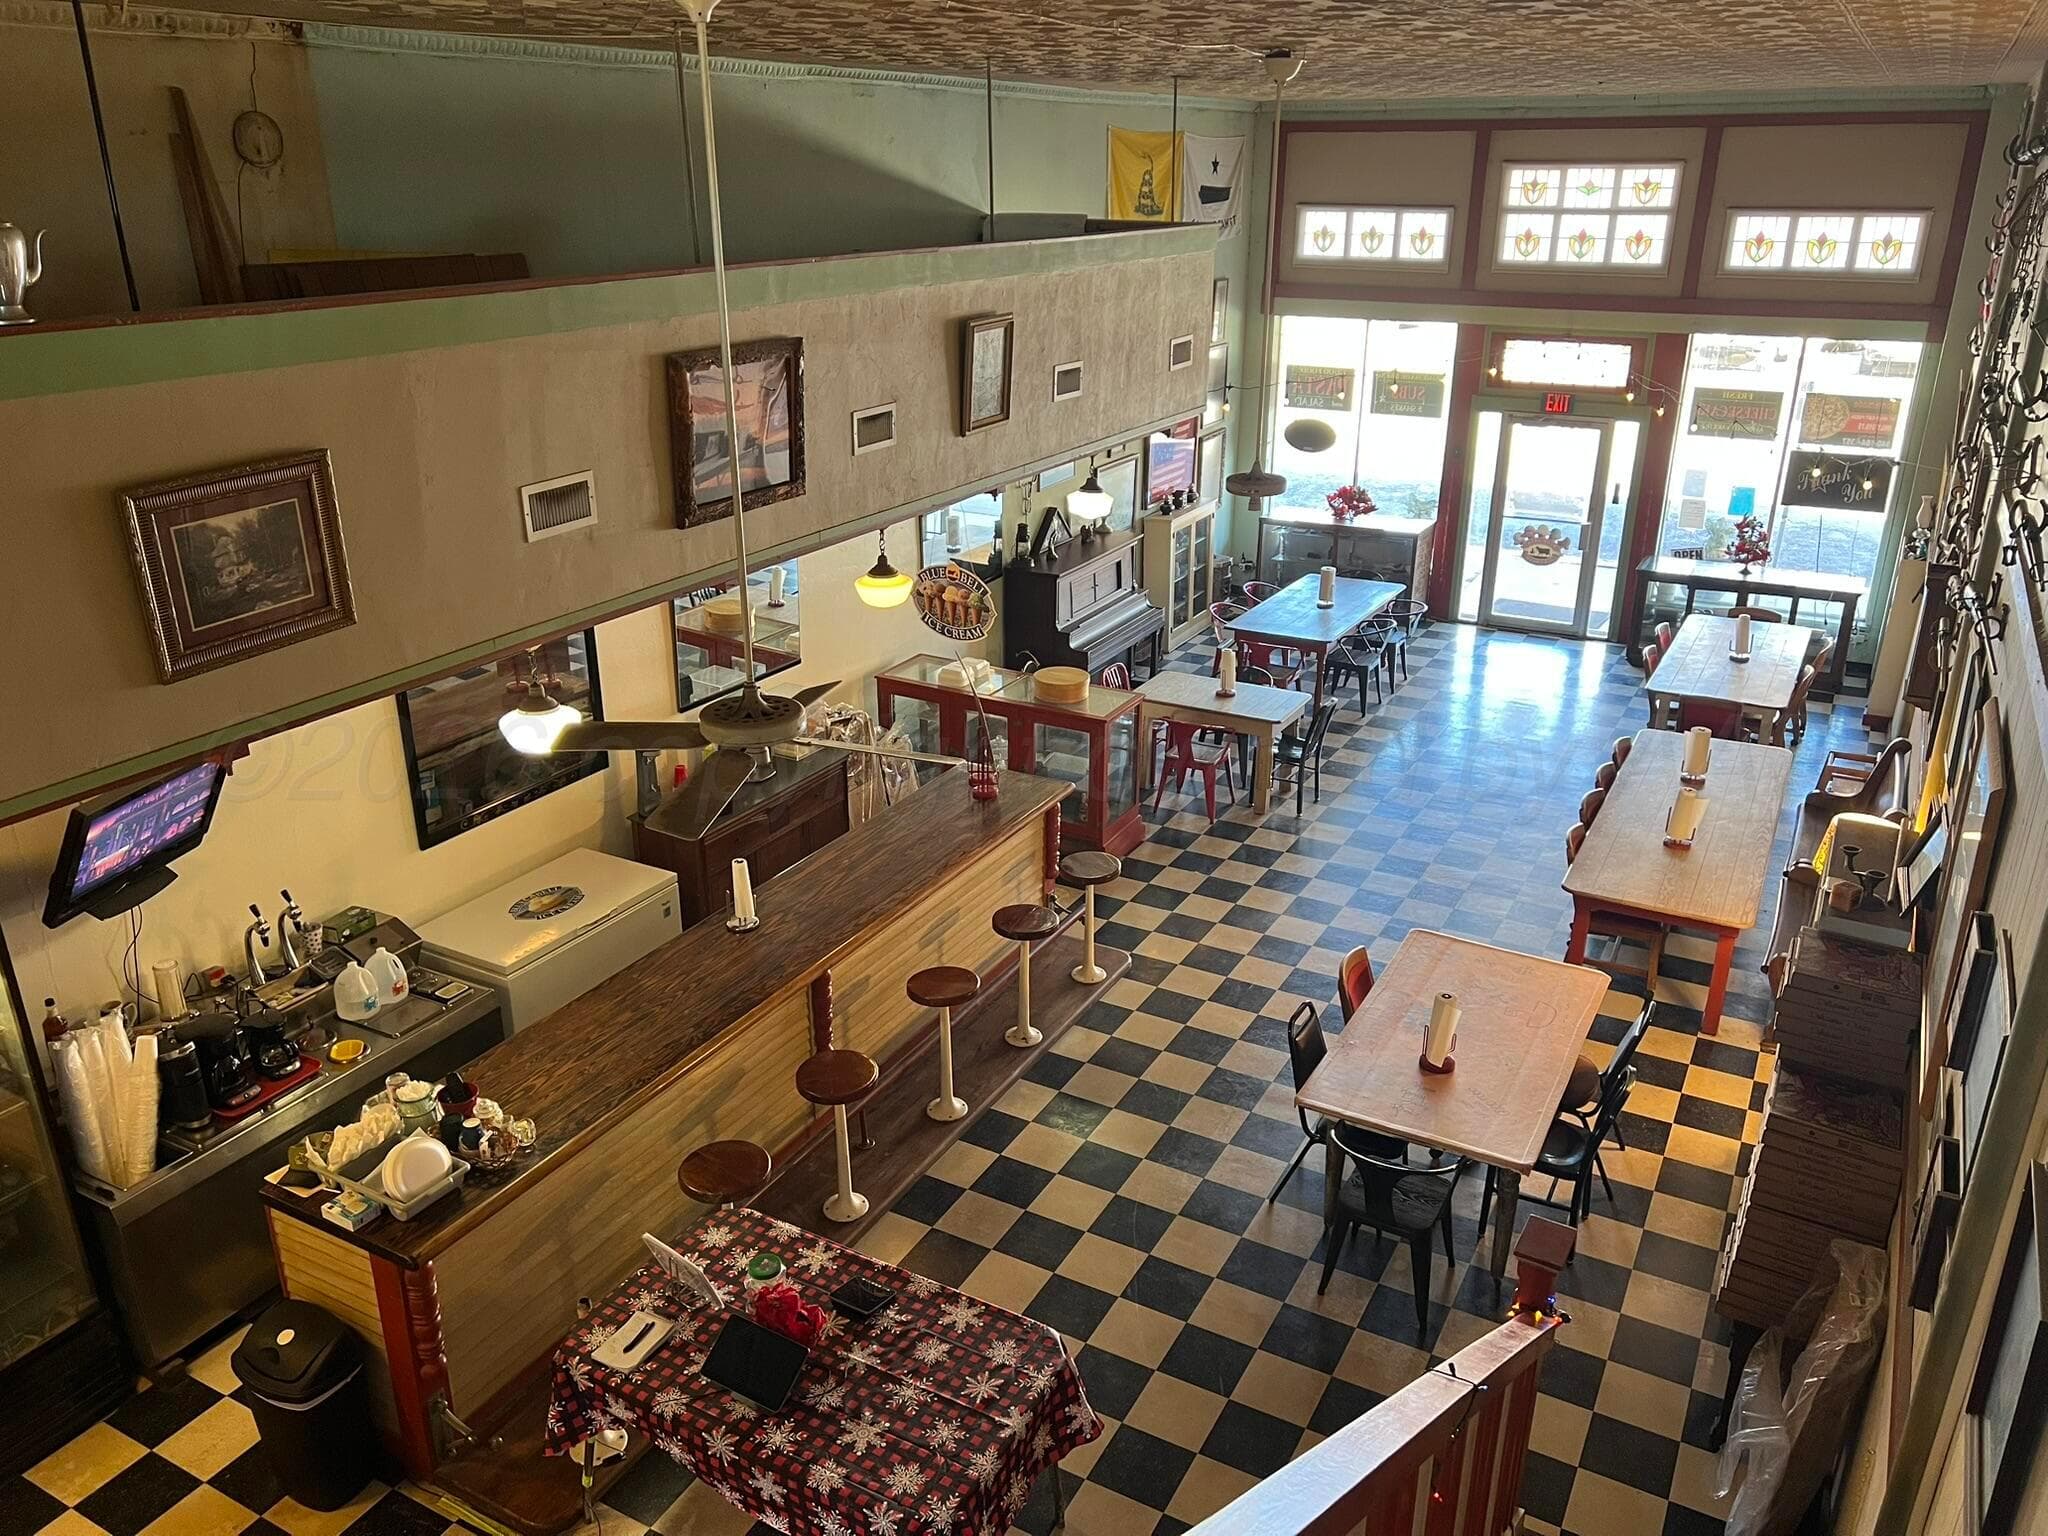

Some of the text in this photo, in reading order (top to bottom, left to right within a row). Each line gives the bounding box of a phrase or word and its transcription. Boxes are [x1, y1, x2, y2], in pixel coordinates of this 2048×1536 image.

[1545, 393, 1571, 413] EXIT
[1842, 483, 1873, 503] You
[1673, 549, 1704, 560] OPEN
[920, 567, 986, 597] BLUE BELL
[924, 614, 982, 640] ICE CREAM
